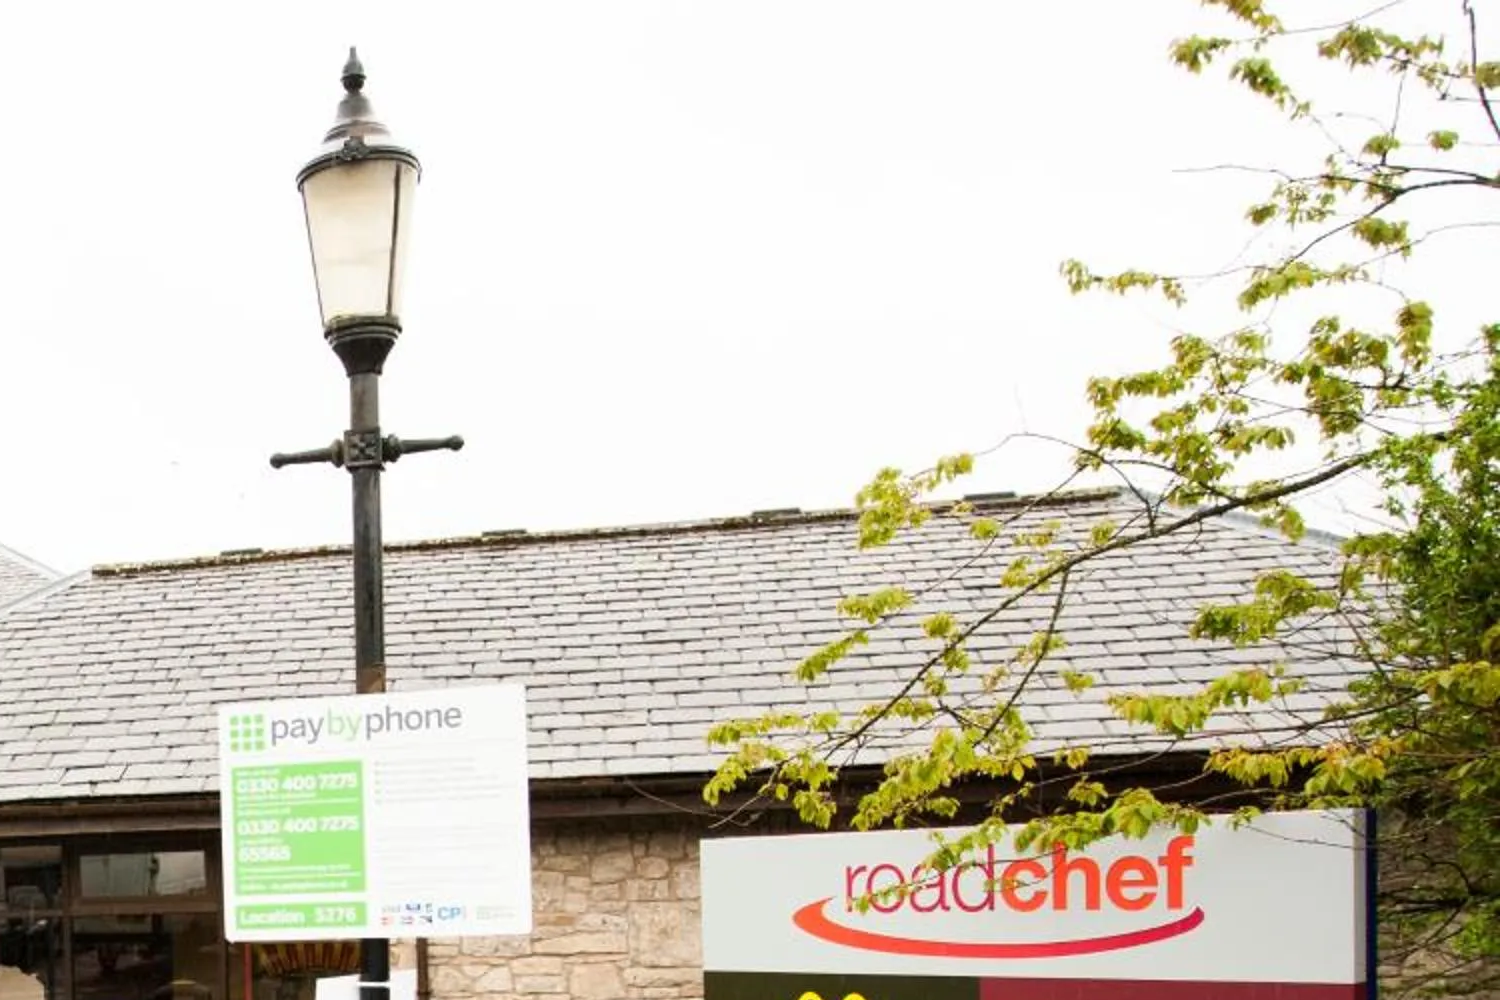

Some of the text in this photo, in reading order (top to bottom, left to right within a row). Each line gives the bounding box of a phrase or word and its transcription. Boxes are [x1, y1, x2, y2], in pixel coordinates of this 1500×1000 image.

[271, 705, 462, 746] paybyphone
[844, 834, 1195, 914] roadchef
[240, 909, 305, 924] Location
